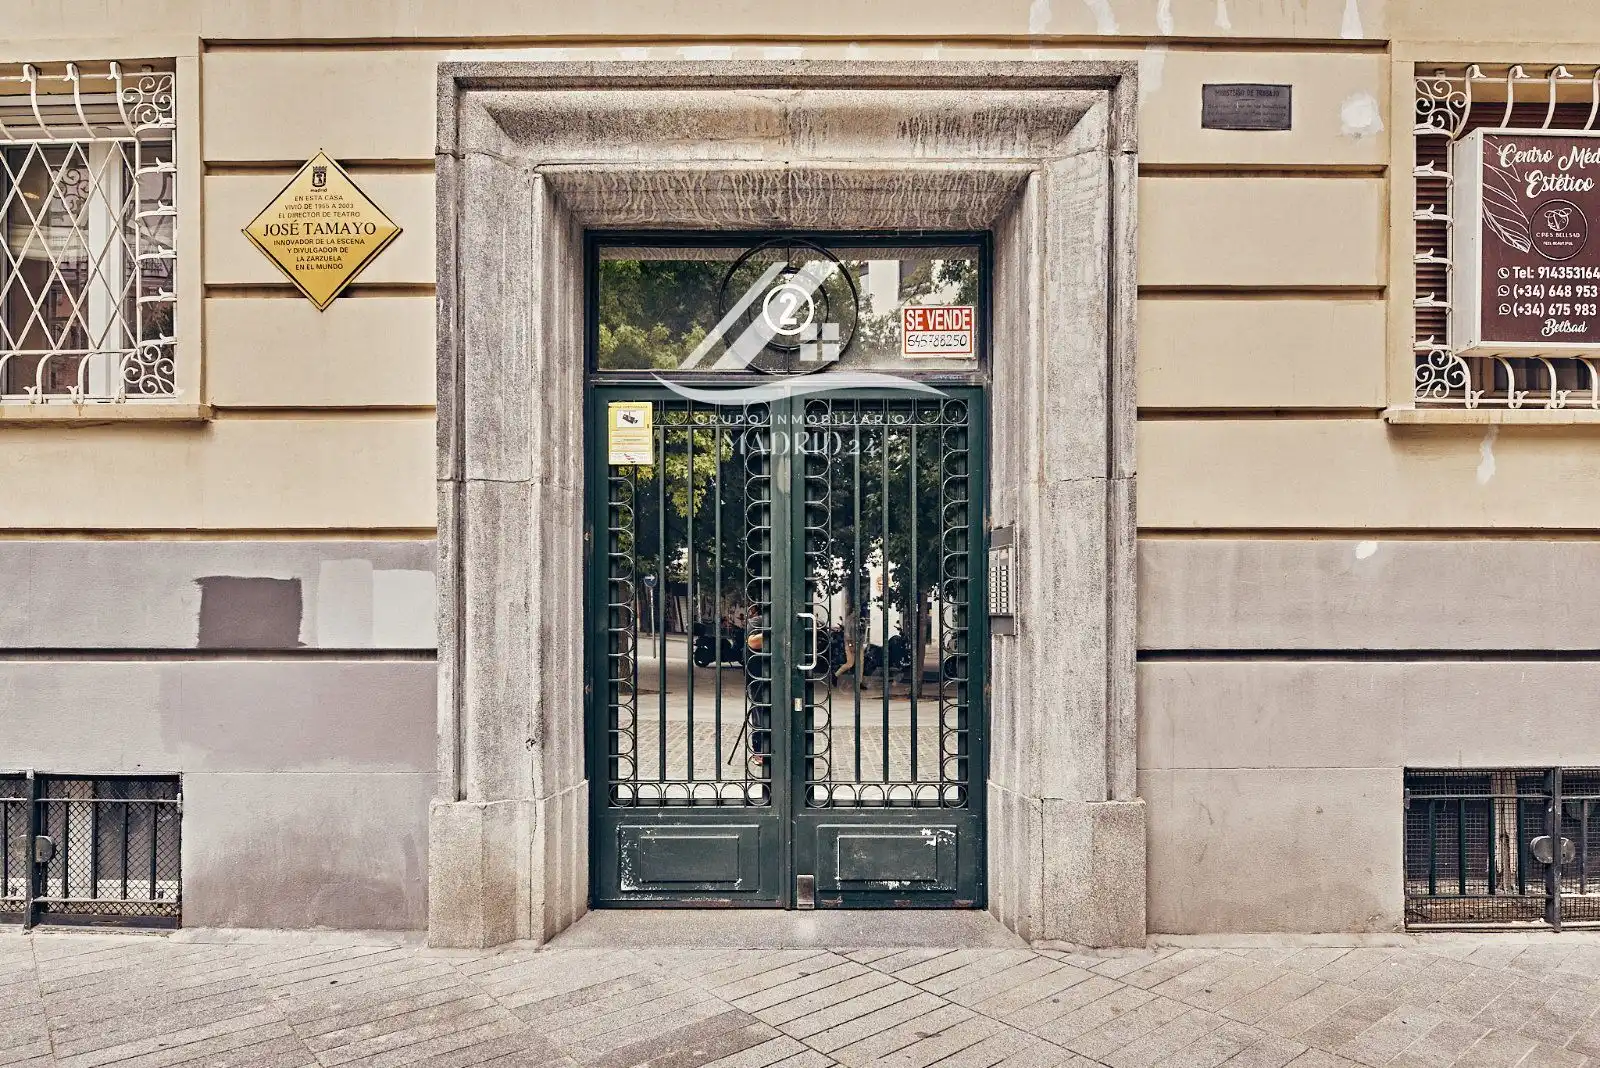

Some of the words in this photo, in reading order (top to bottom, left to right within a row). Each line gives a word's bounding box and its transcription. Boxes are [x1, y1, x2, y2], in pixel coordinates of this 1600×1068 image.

[1498, 143, 1555, 168] Centro
[1524, 169, 1595, 199] Estético
[263, 220, 300, 237] JOSÉ
[303, 222, 377, 236] TAMAYO
[273, 238, 314, 246] INNOVADOR
[1512, 266, 1535, 279] Tel:
[1537, 266, 1600, 279] 914353164
[1513, 284, 1545, 299] (+34)
[1548, 285, 1572, 297] 648
[1575, 285, 1598, 297] 953
[779, 293, 798, 325] 2
[1513, 302, 1545, 318] (+34)
[1548, 303, 1571, 316] 675
[1574, 303, 1597, 316] 983
[905, 309, 924, 331] SE
[926, 309, 971, 330] VENDE
[1541, 318, 1588, 337] Bellsad
